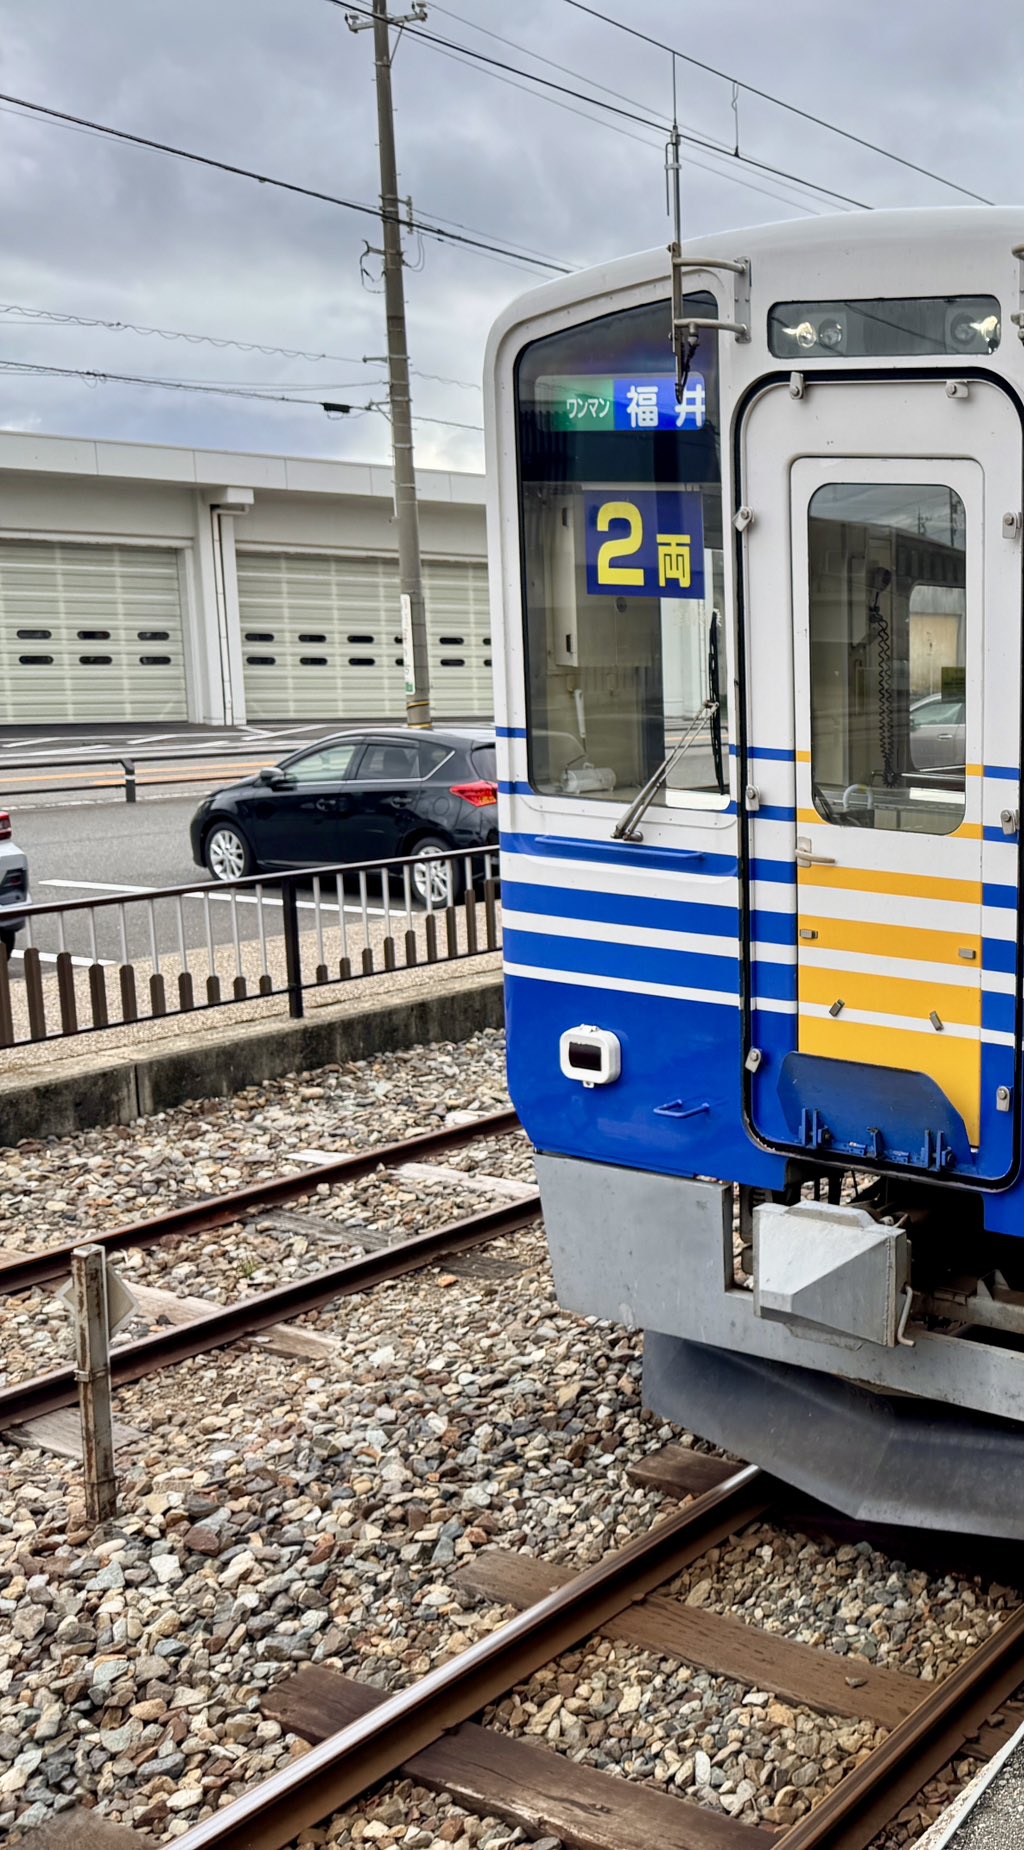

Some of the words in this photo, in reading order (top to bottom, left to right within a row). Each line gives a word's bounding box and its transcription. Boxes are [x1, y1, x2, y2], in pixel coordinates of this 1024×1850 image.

[566, 397, 610, 420] ワンマン
[626, 383, 706, 429] 福井
